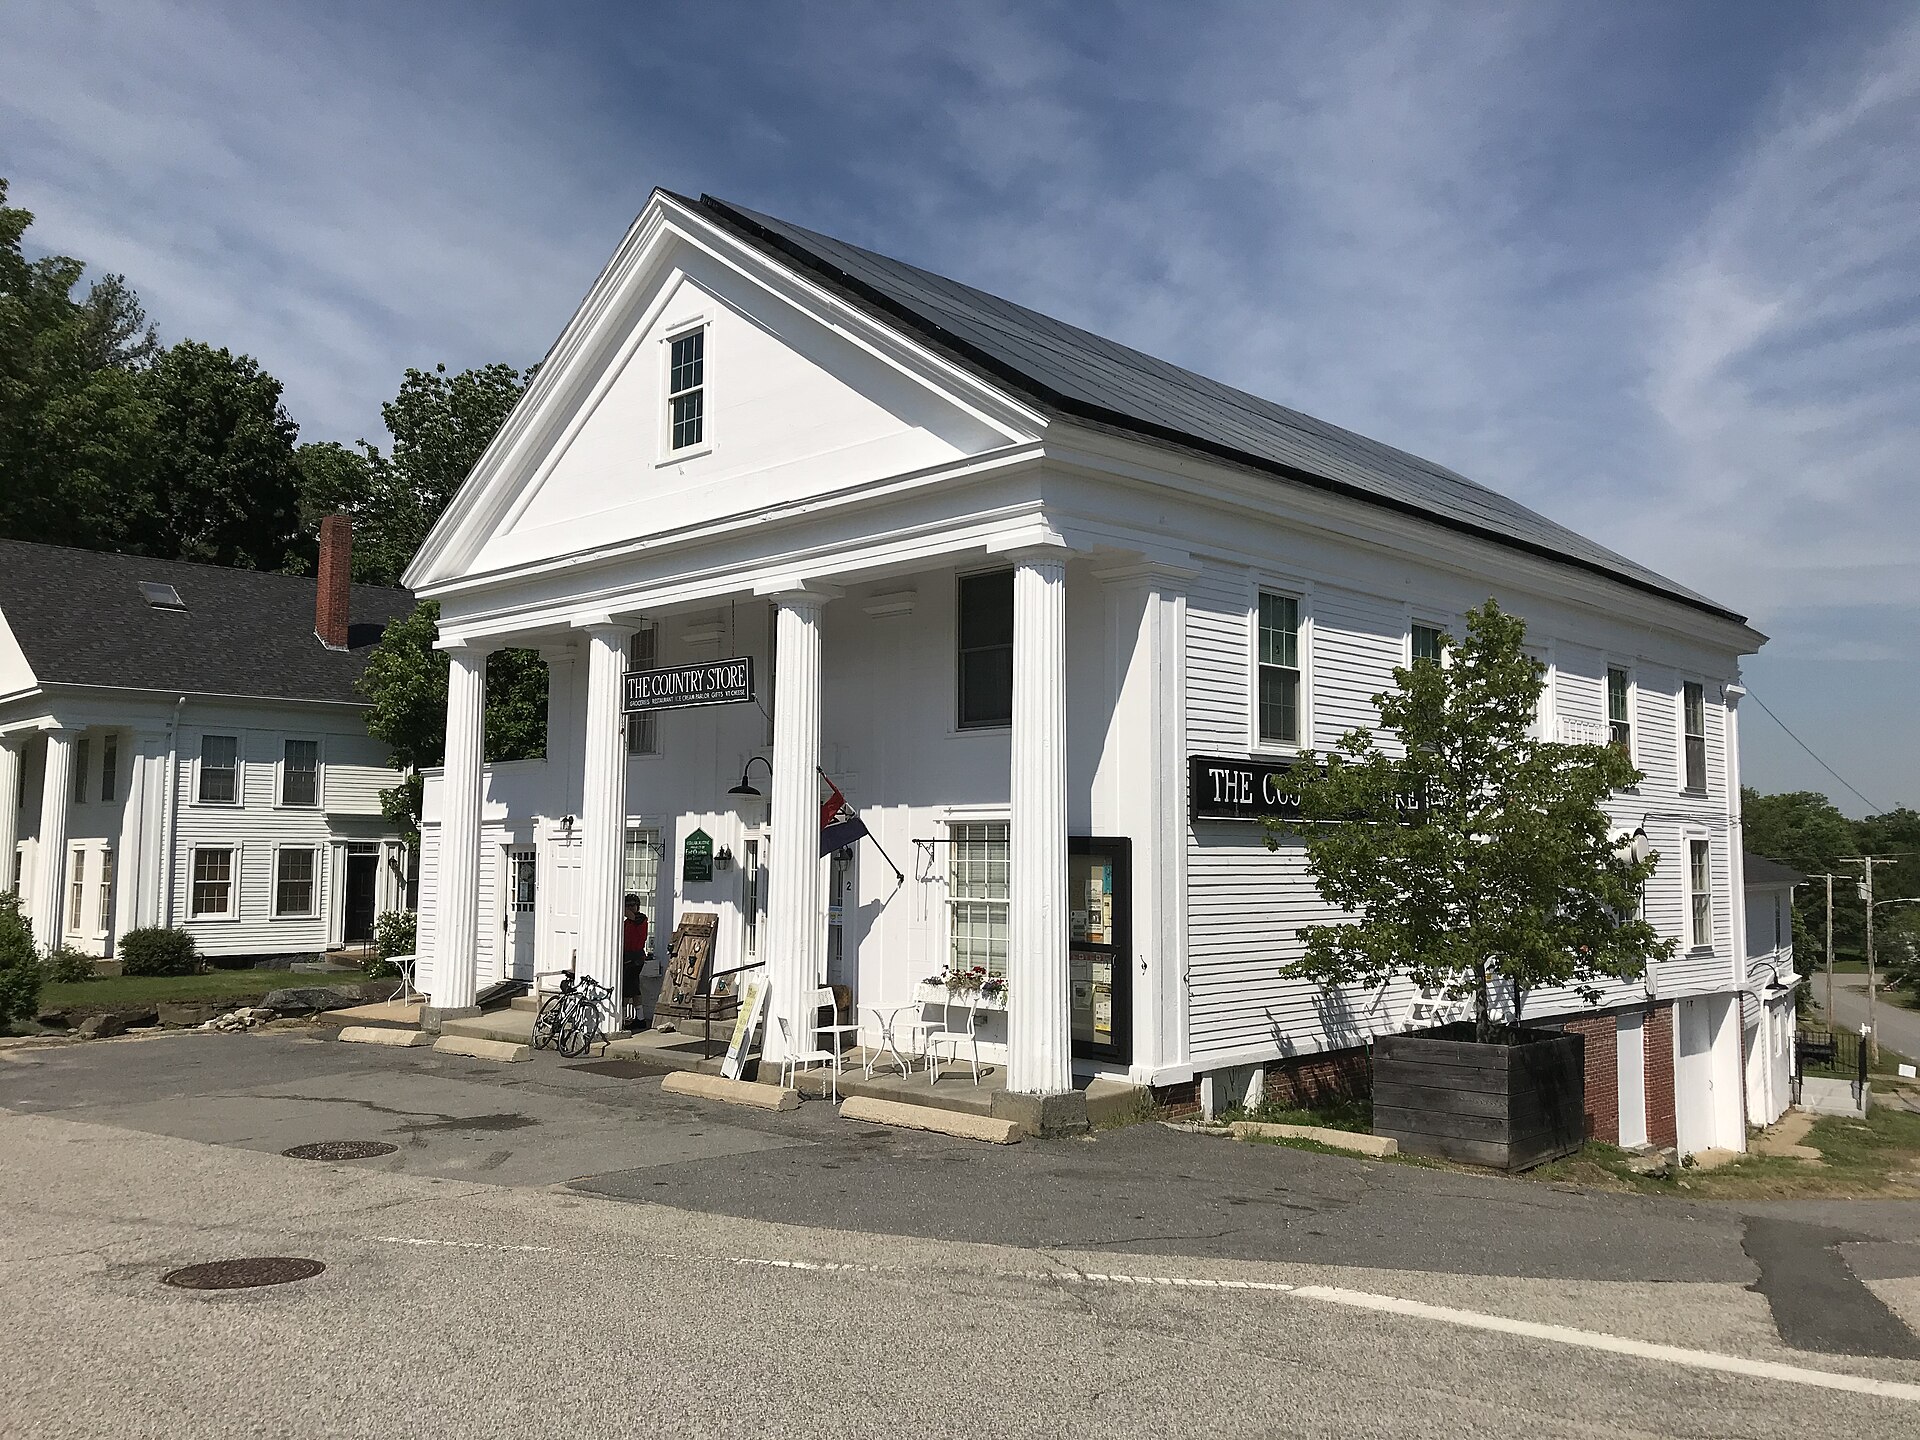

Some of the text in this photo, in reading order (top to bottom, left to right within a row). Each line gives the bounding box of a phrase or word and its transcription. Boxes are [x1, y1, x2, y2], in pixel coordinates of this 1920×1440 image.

[627, 665, 745, 699] THE COUNTRY STORE
[652, 696, 673, 705] RESTAURANT
[682, 694, 695, 702] CREAM
[1208, 768, 1253, 804] THE
[846, 881, 852, 891] 2
